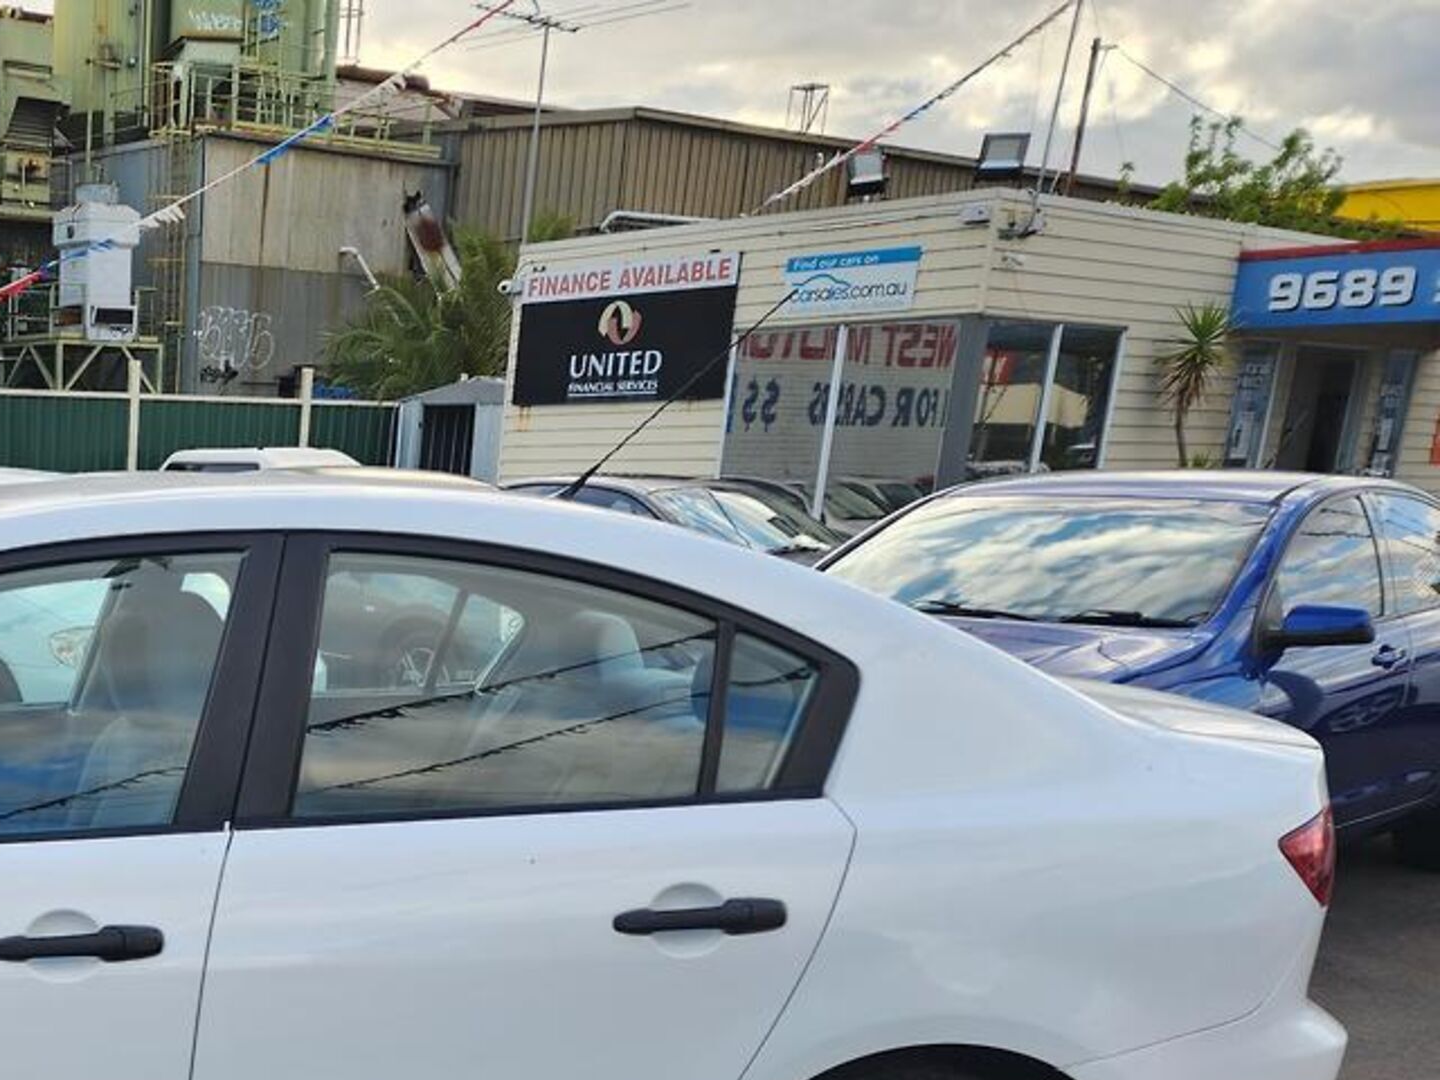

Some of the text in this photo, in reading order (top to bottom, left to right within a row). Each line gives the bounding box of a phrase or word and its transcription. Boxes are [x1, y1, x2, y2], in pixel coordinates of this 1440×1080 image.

[864, 255, 880, 264] on
[528, 258, 733, 297] FINANCE AVAILABLE
[1267, 266, 1417, 313] 9689
[570, 349, 663, 378] UNITED
